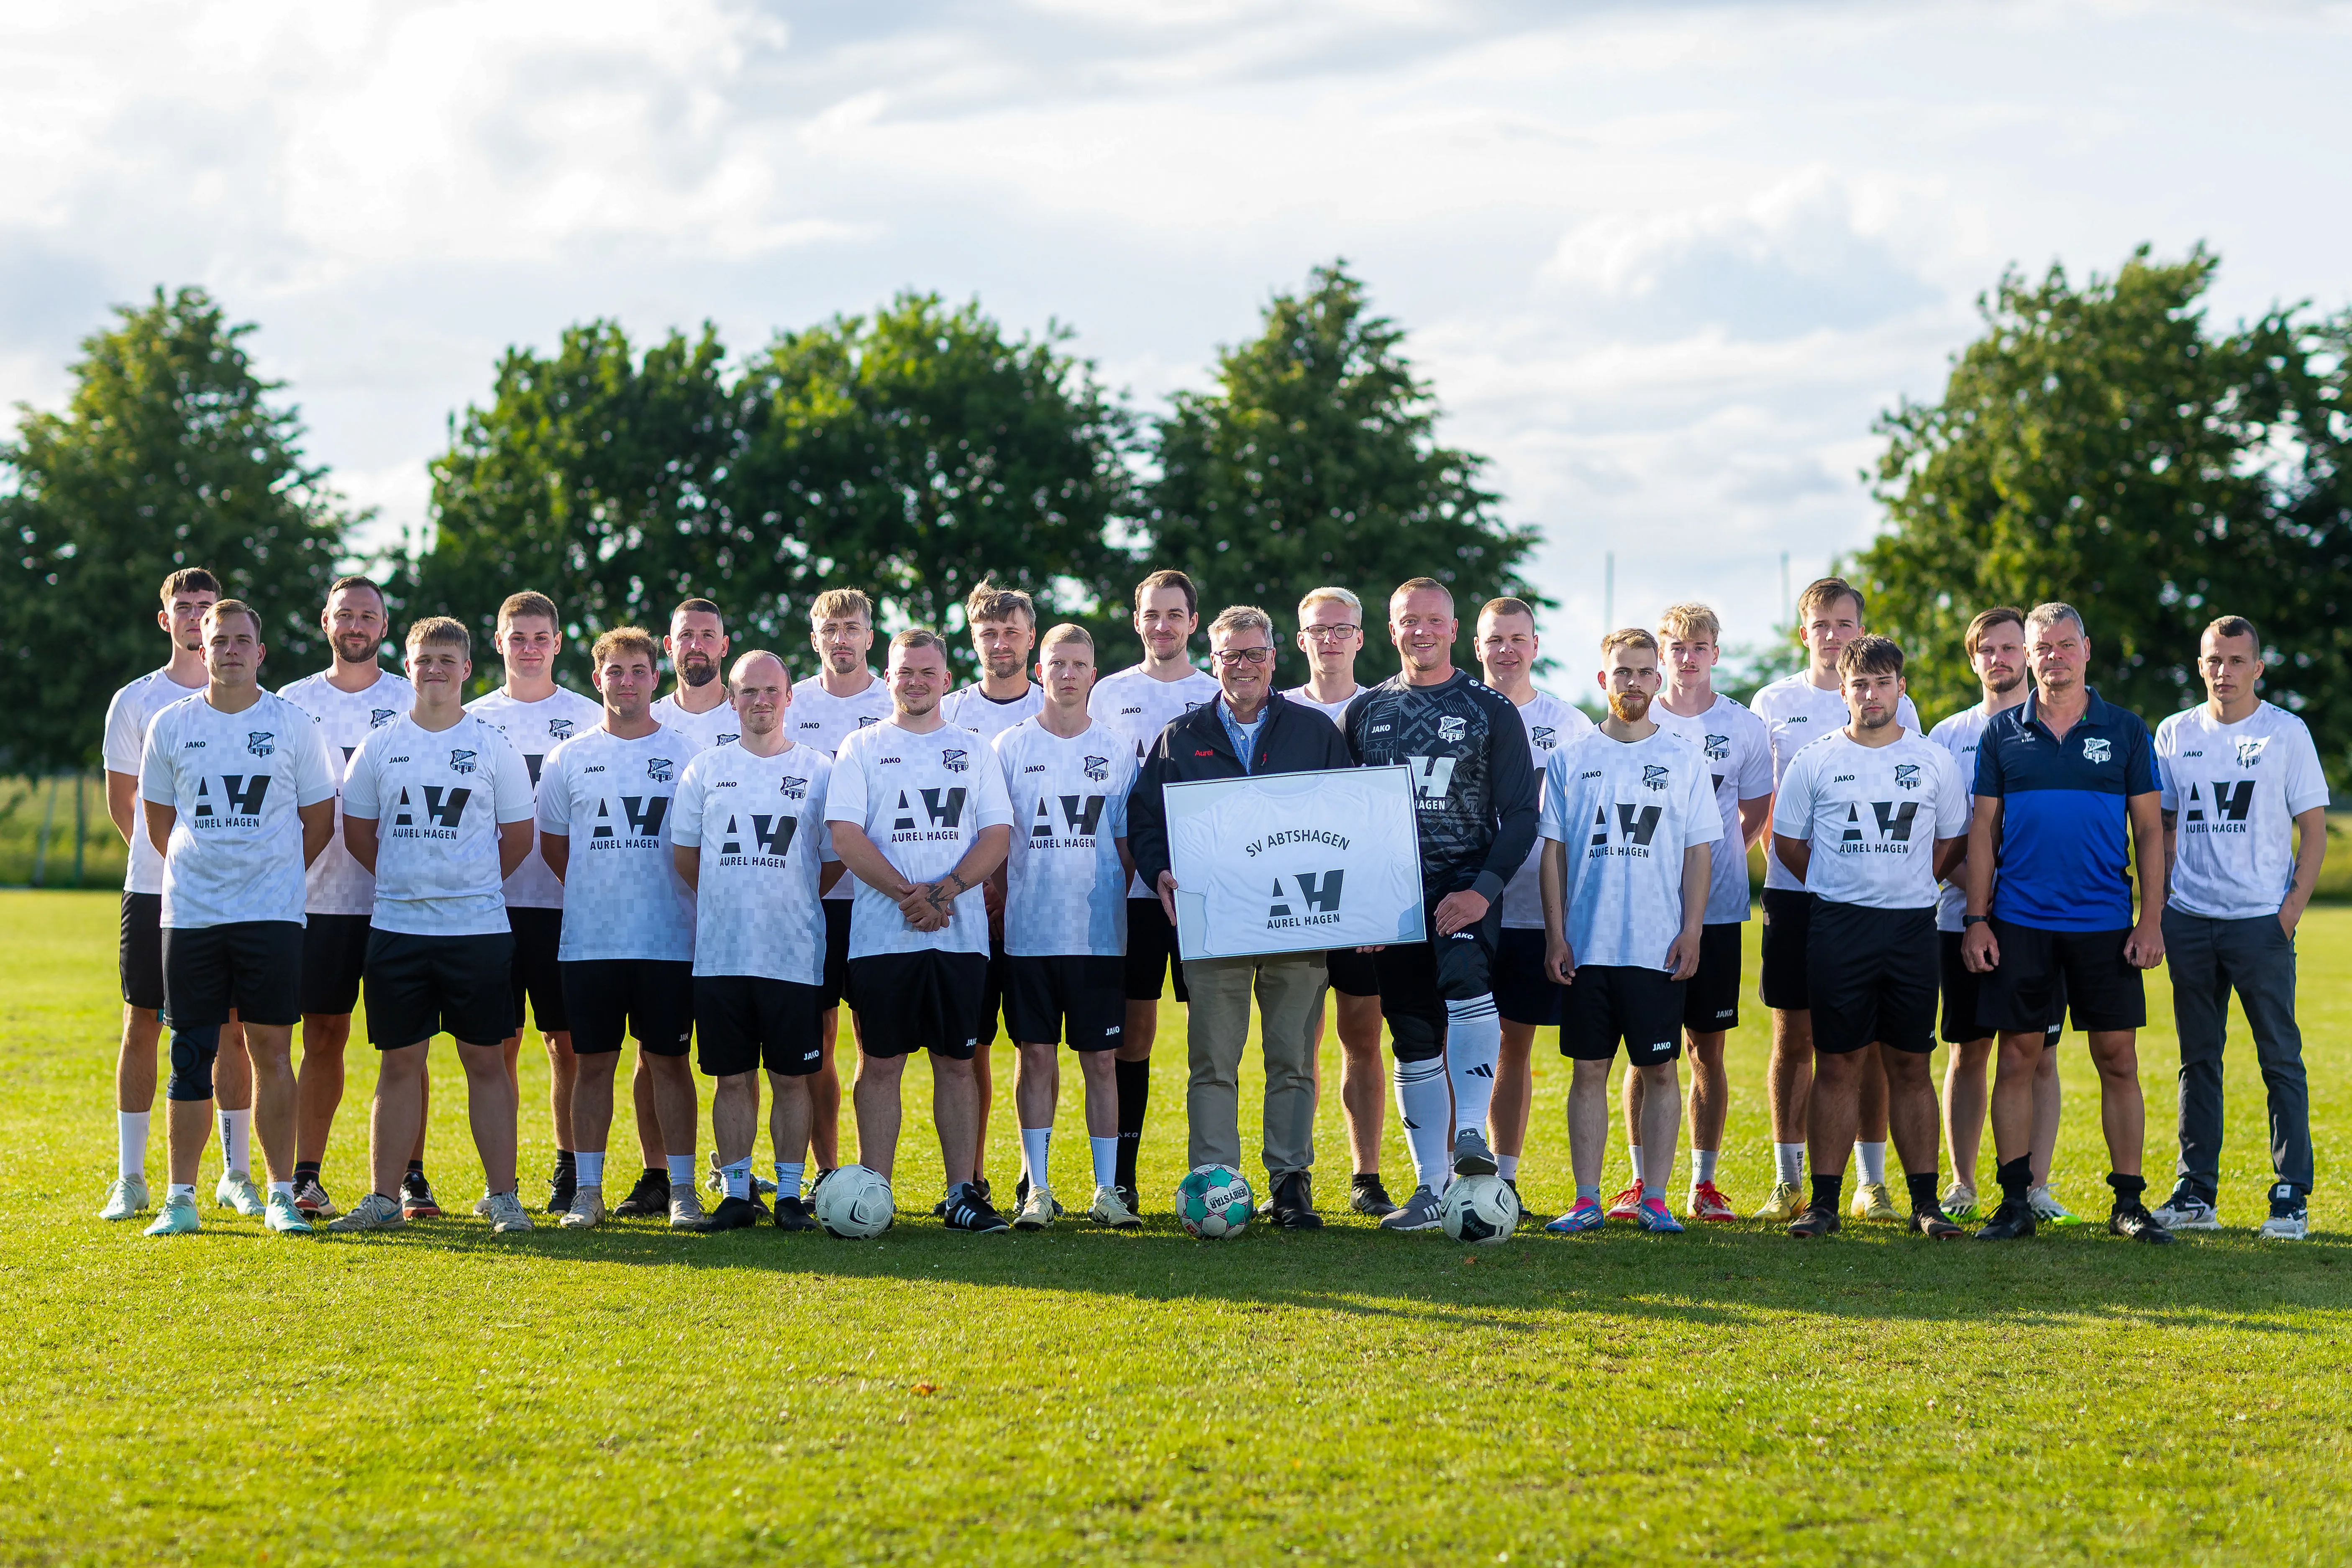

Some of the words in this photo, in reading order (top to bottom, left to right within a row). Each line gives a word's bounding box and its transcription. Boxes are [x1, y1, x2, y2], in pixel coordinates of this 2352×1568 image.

[1372, 724, 1391, 733] JAKO
[1581, 771, 1601, 779] JAKO
[1834, 774, 1855, 783] JAKO
[195, 818, 221, 829] AUREL
[225, 817, 259, 828] HAGEN
[2185, 823, 2209, 834] AUREL
[2212, 823, 2246, 833] HAGEN
[392, 828, 420, 838] AUREL
[423, 829, 457, 840] HAGEN
[891, 832, 923, 843] AUREL
[926, 830, 959, 840] HAGEN
[590, 840, 621, 851] AUREL
[625, 839, 659, 849] HAGEN
[1028, 839, 1061, 849] AUREL
[1064, 838, 1096, 848] HAGEN
[1245, 839, 1262, 857] SV
[1268, 829, 1350, 851] ABTSHAGEN
[1839, 843, 1870, 853] AUREL
[1875, 843, 1909, 854] HAGEN
[1588, 846, 1614, 858] AUREL
[1617, 847, 1649, 858] HAGEN
[719, 857, 748, 866] AUREL
[751, 856, 786, 869] HAGEN
[1266, 917, 1301, 929] AUREL
[1304, 913, 1340, 926] HAGEN
[1716, 1009, 1733, 1018] JAKO
[1106, 1026, 1120, 1035] JAKO
[2047, 1024, 2060, 1034] JAKO
[679, 1033, 688, 1041] JAK
[1653, 1042, 1671, 1051] JAKO
[804, 1050, 819, 1060] JAKO
[1209, 1187, 1248, 1209] DERBYSTAR
[1464, 1220, 1486, 1236] JAKO
